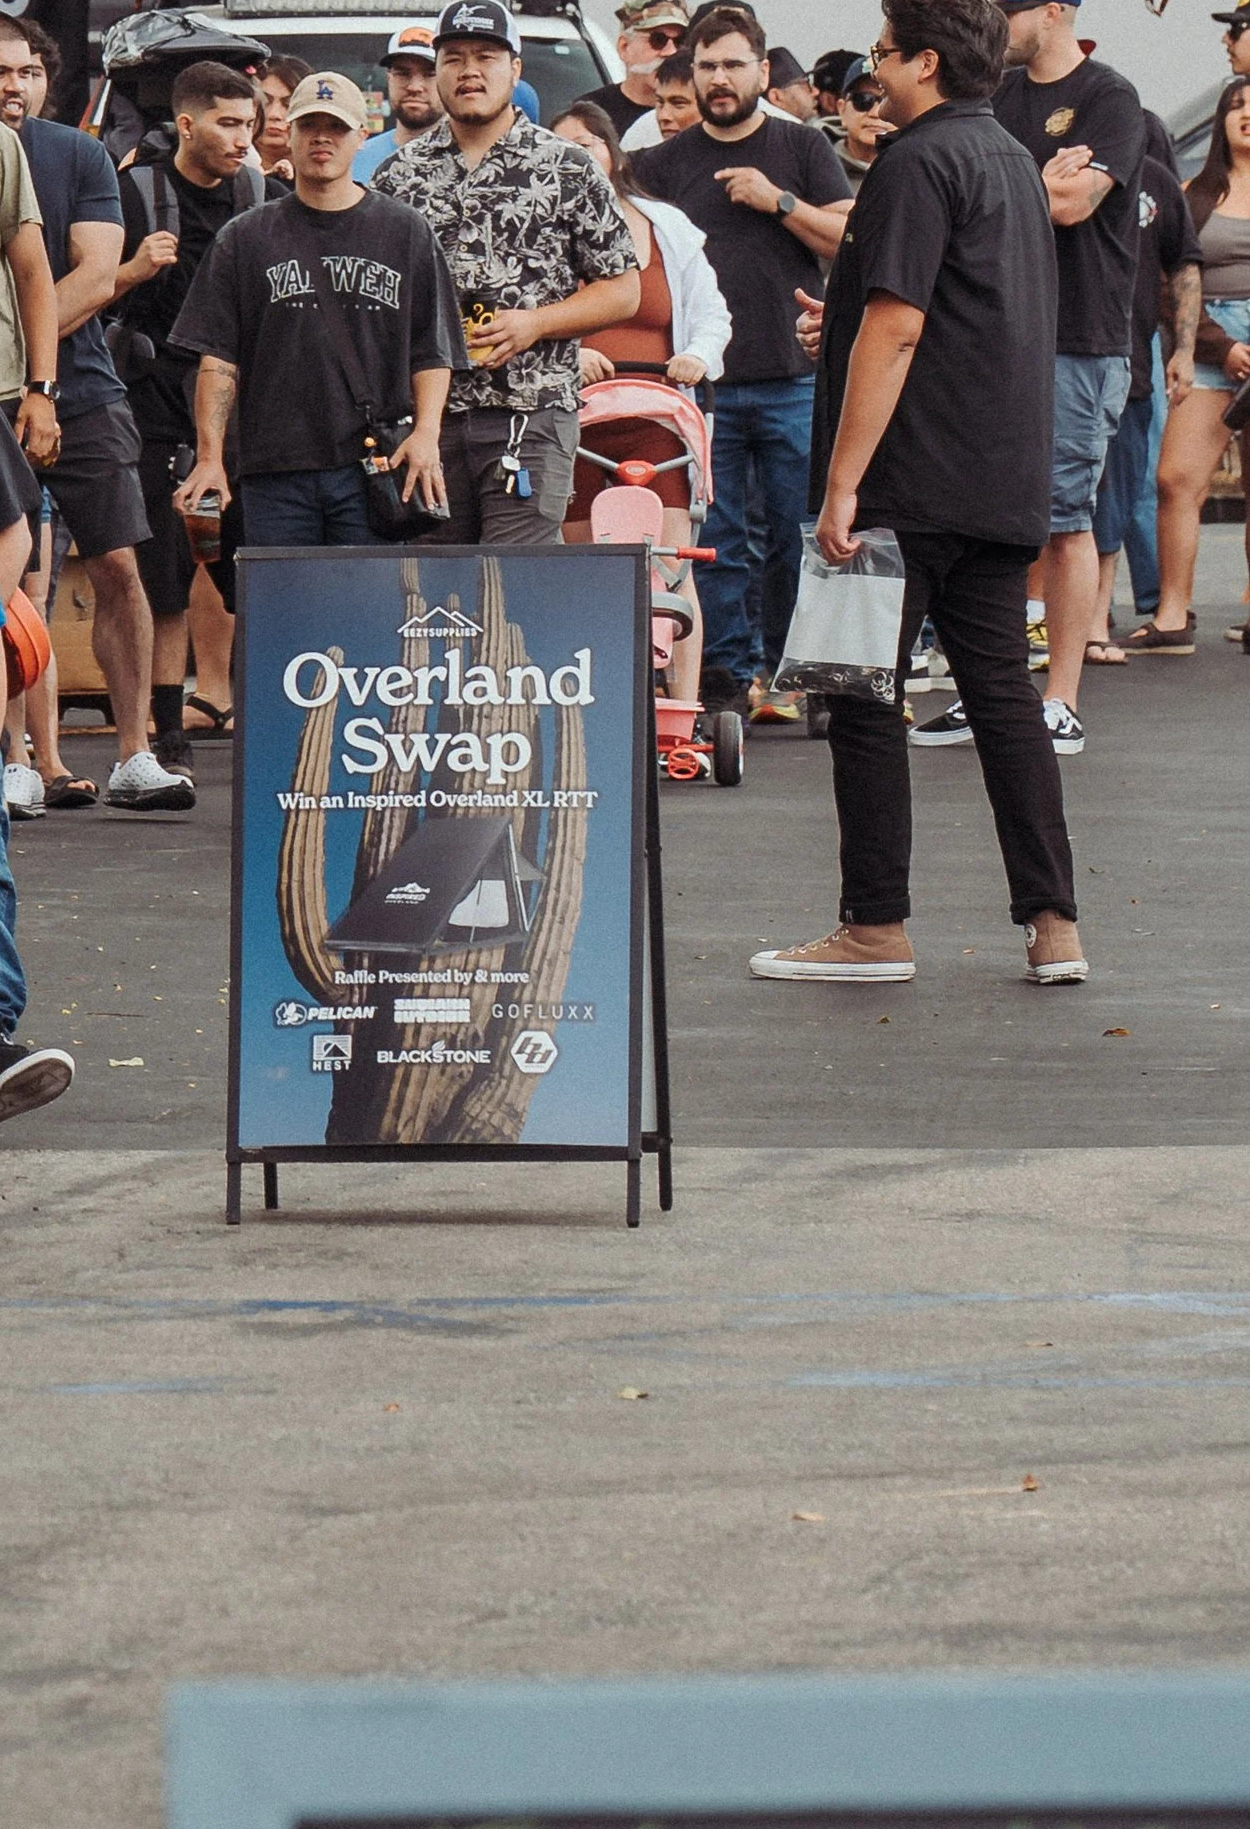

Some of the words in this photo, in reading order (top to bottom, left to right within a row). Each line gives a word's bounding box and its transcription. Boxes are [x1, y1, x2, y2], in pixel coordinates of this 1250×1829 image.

[282, 647, 596, 708] Overland
[341, 717, 533, 785] Swap
[276, 792, 317, 810] Win
[319, 794, 345, 809] an
[347, 791, 427, 811] Inspired
[429, 789, 520, 808] Overland
[521, 790, 550, 808] XL
[553, 790, 599, 809] RTT
[334, 970, 376, 984] Raffle
[378, 969, 452, 984] Presented
[454, 970, 472, 986] by
[474, 969, 489, 983] &
[491, 971, 530, 984] more
[307, 1006, 376, 1021] PELICAN
[491, 1003, 594, 1020] GOFLUXX
[312, 1060, 351, 1071] HEST
[377, 1050, 491, 1064] BLACKSTONE
